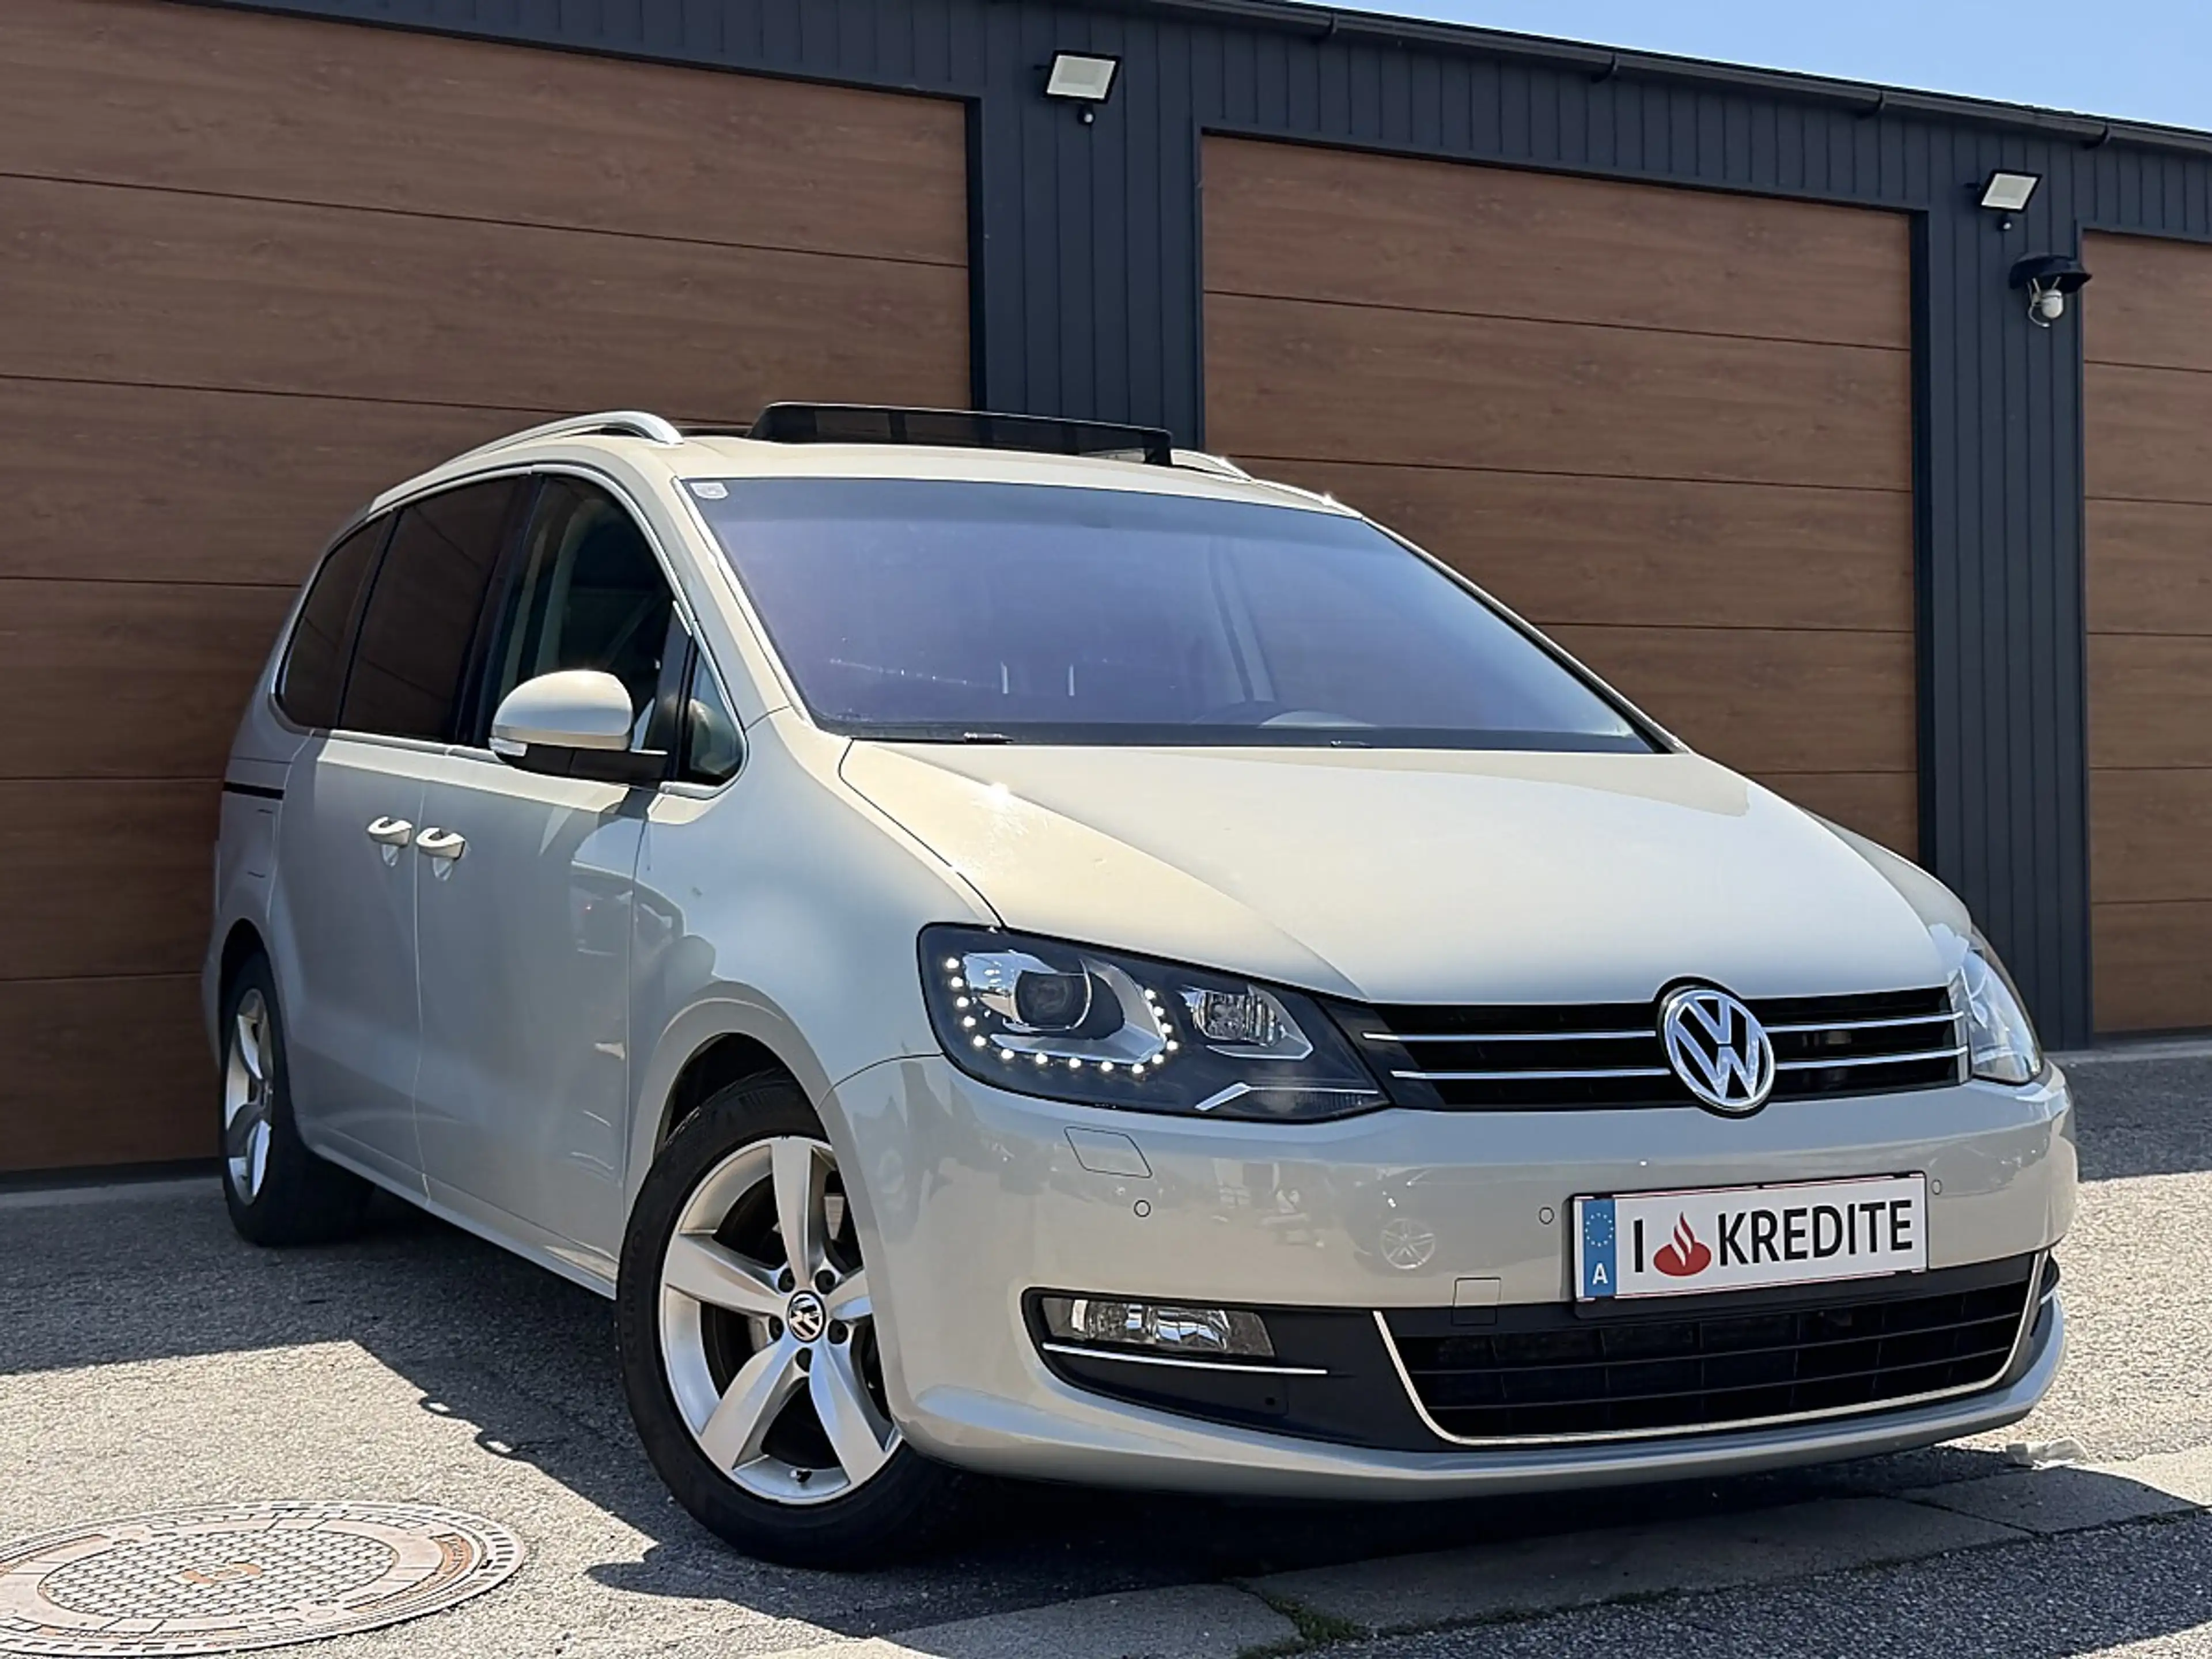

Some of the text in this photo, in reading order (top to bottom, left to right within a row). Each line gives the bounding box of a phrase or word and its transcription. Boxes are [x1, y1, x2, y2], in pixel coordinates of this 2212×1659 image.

[1664, 988, 1775, 1111] VW
[1634, 1199, 1912, 1273] I KREDITE
[1592, 1263, 1608, 1285] A
